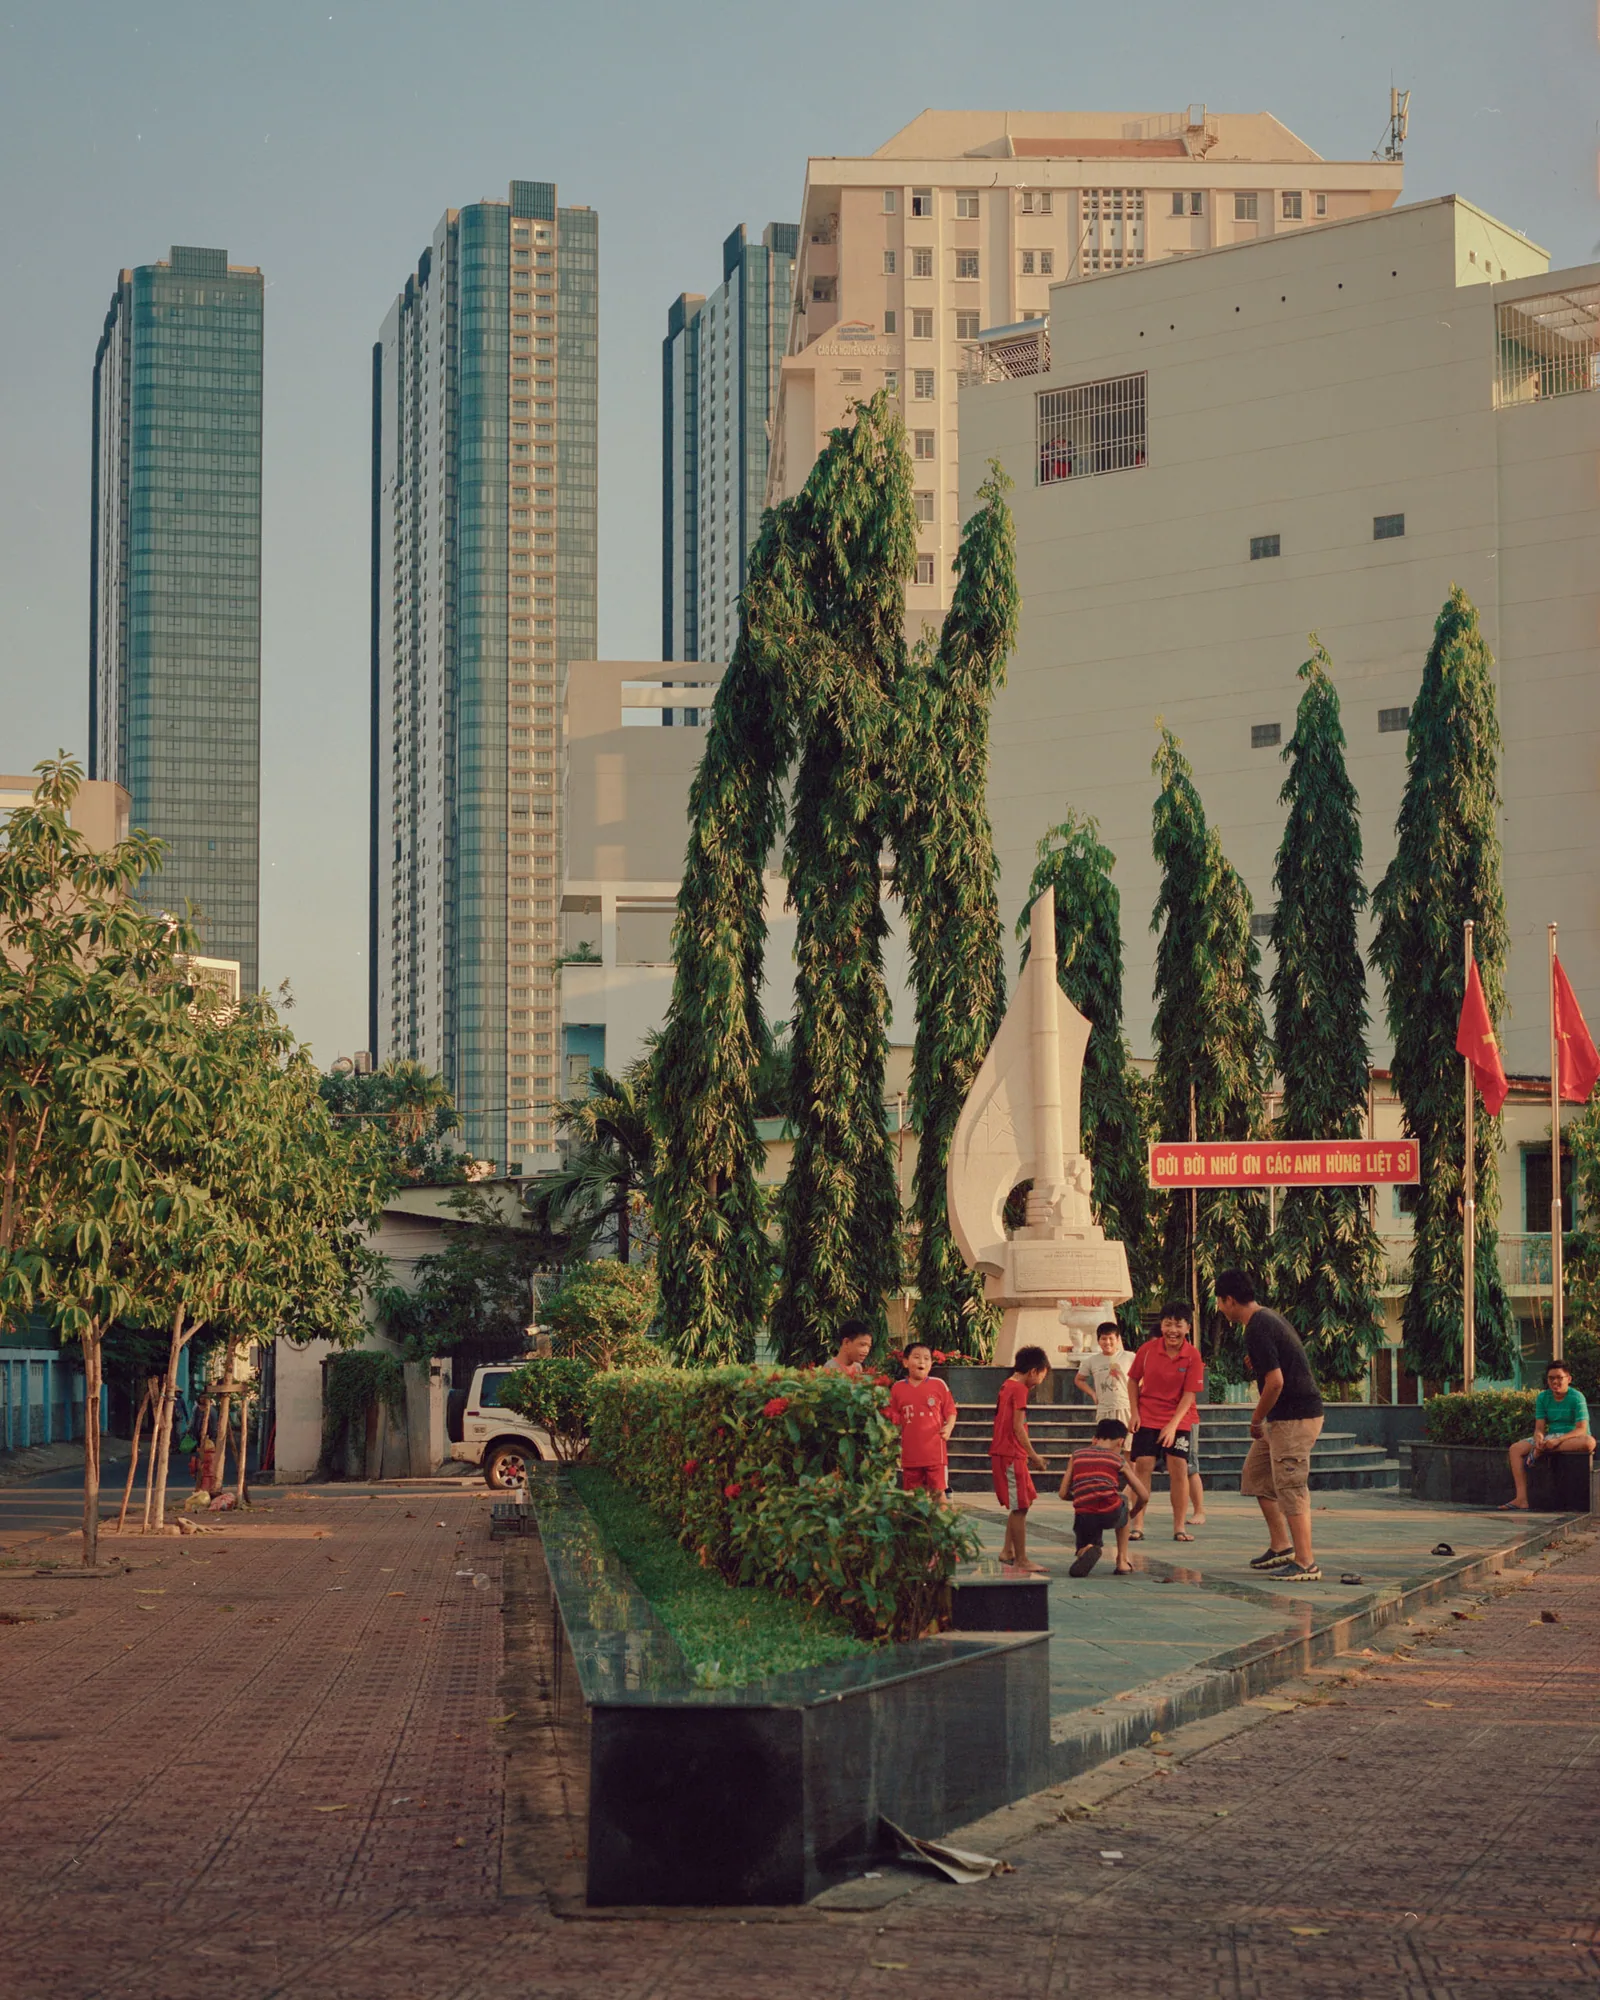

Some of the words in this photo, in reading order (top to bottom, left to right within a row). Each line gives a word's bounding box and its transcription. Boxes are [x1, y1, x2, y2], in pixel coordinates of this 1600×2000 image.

[1156, 1152, 1179, 1176] ĐỜI
[1183, 1152, 1206, 1176] ĐỜI
[1210, 1151, 1238, 1175] NHỚ
[1242, 1153, 1261, 1175] ƠN
[1266, 1151, 1292, 1175] CÁC
[1294, 1154, 1321, 1174] ANH
[1325, 1150, 1362, 1174] HÙNG
[1366, 1149, 1393, 1176] LIỆT
[1397, 1149, 1411, 1173] SĨ
